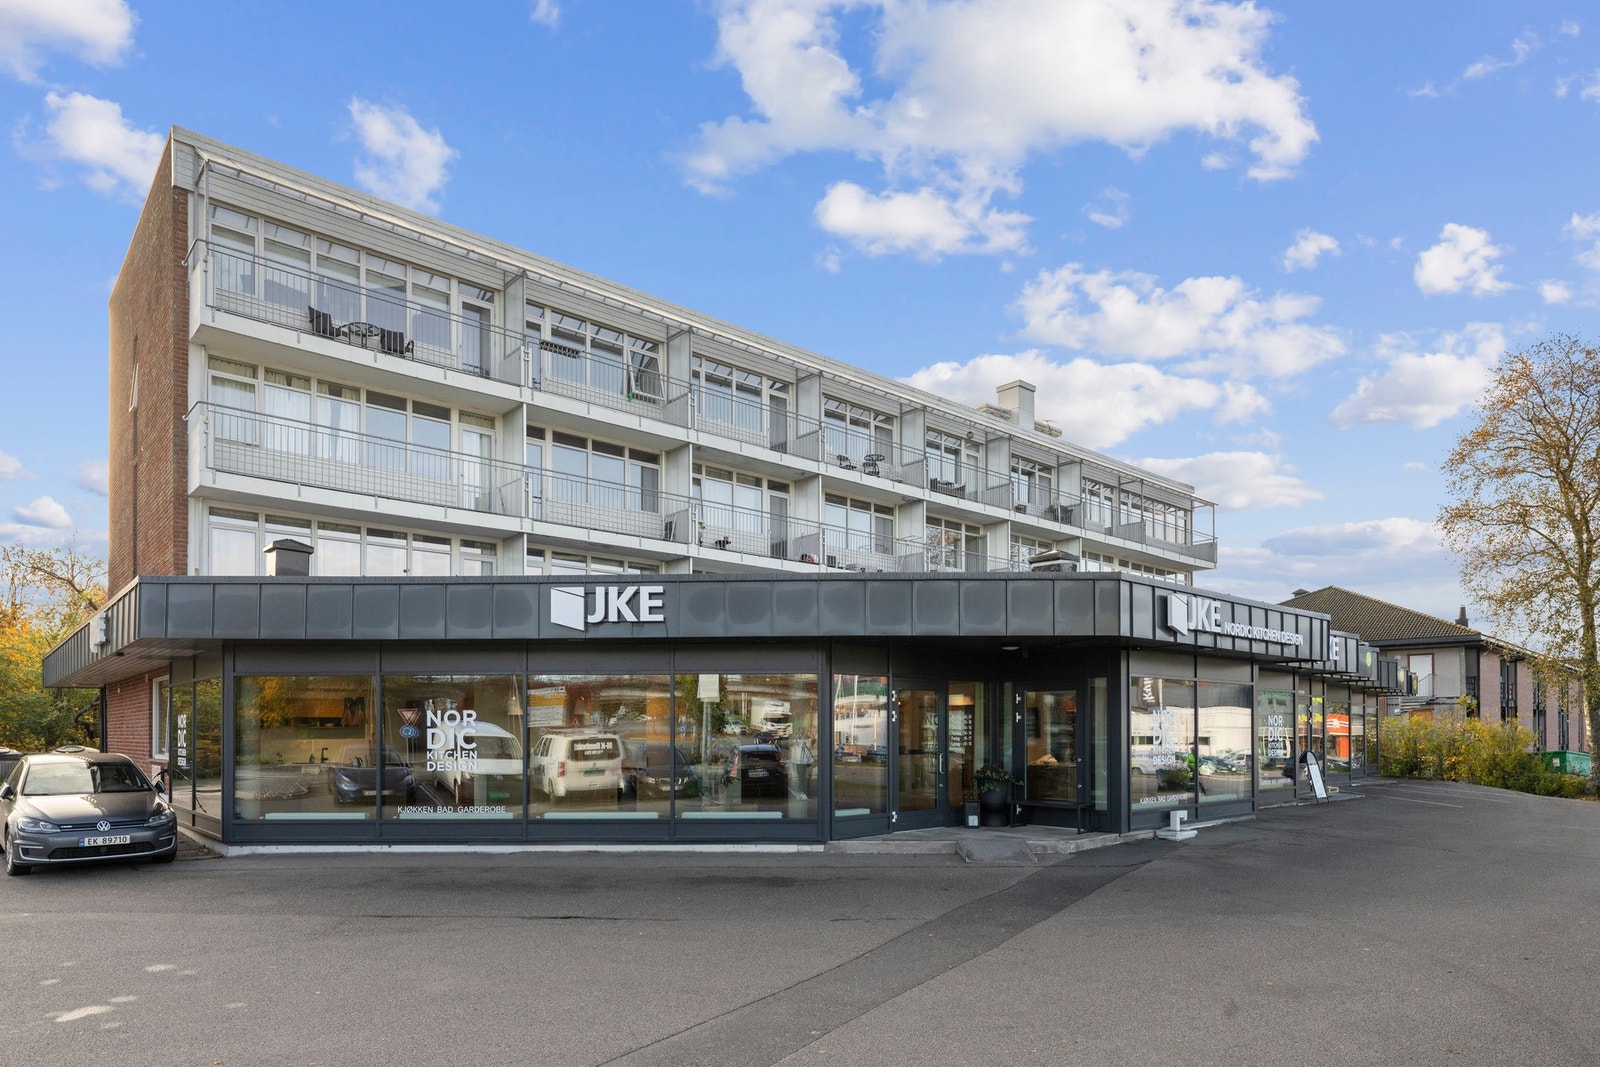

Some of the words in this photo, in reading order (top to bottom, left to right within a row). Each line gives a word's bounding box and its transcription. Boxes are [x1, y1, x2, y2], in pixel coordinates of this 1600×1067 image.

[587, 585, 665, 624] JKE
[1188, 595, 1221, 633] JKE
[1224, 621, 1253, 638] NORDIC
[1253, 626, 1280, 642] KITCHEN
[1281, 630, 1304, 646] DESIGN
[426, 709, 478, 727] NOR
[1268, 715, 1283, 727] NOR
[426, 728, 478, 750] DIC
[1268, 727, 1283, 742] DIC
[426, 750, 478, 760] KITCHEN
[426, 761, 478, 772] DESIGN
[397, 805, 434, 813] KJØKKEN
[437, 805, 454, 813] BAD
[457, 805, 506, 813] GARDEROBE
[87, 838, 98, 846] EK
[102, 836, 127, 845] 89710
